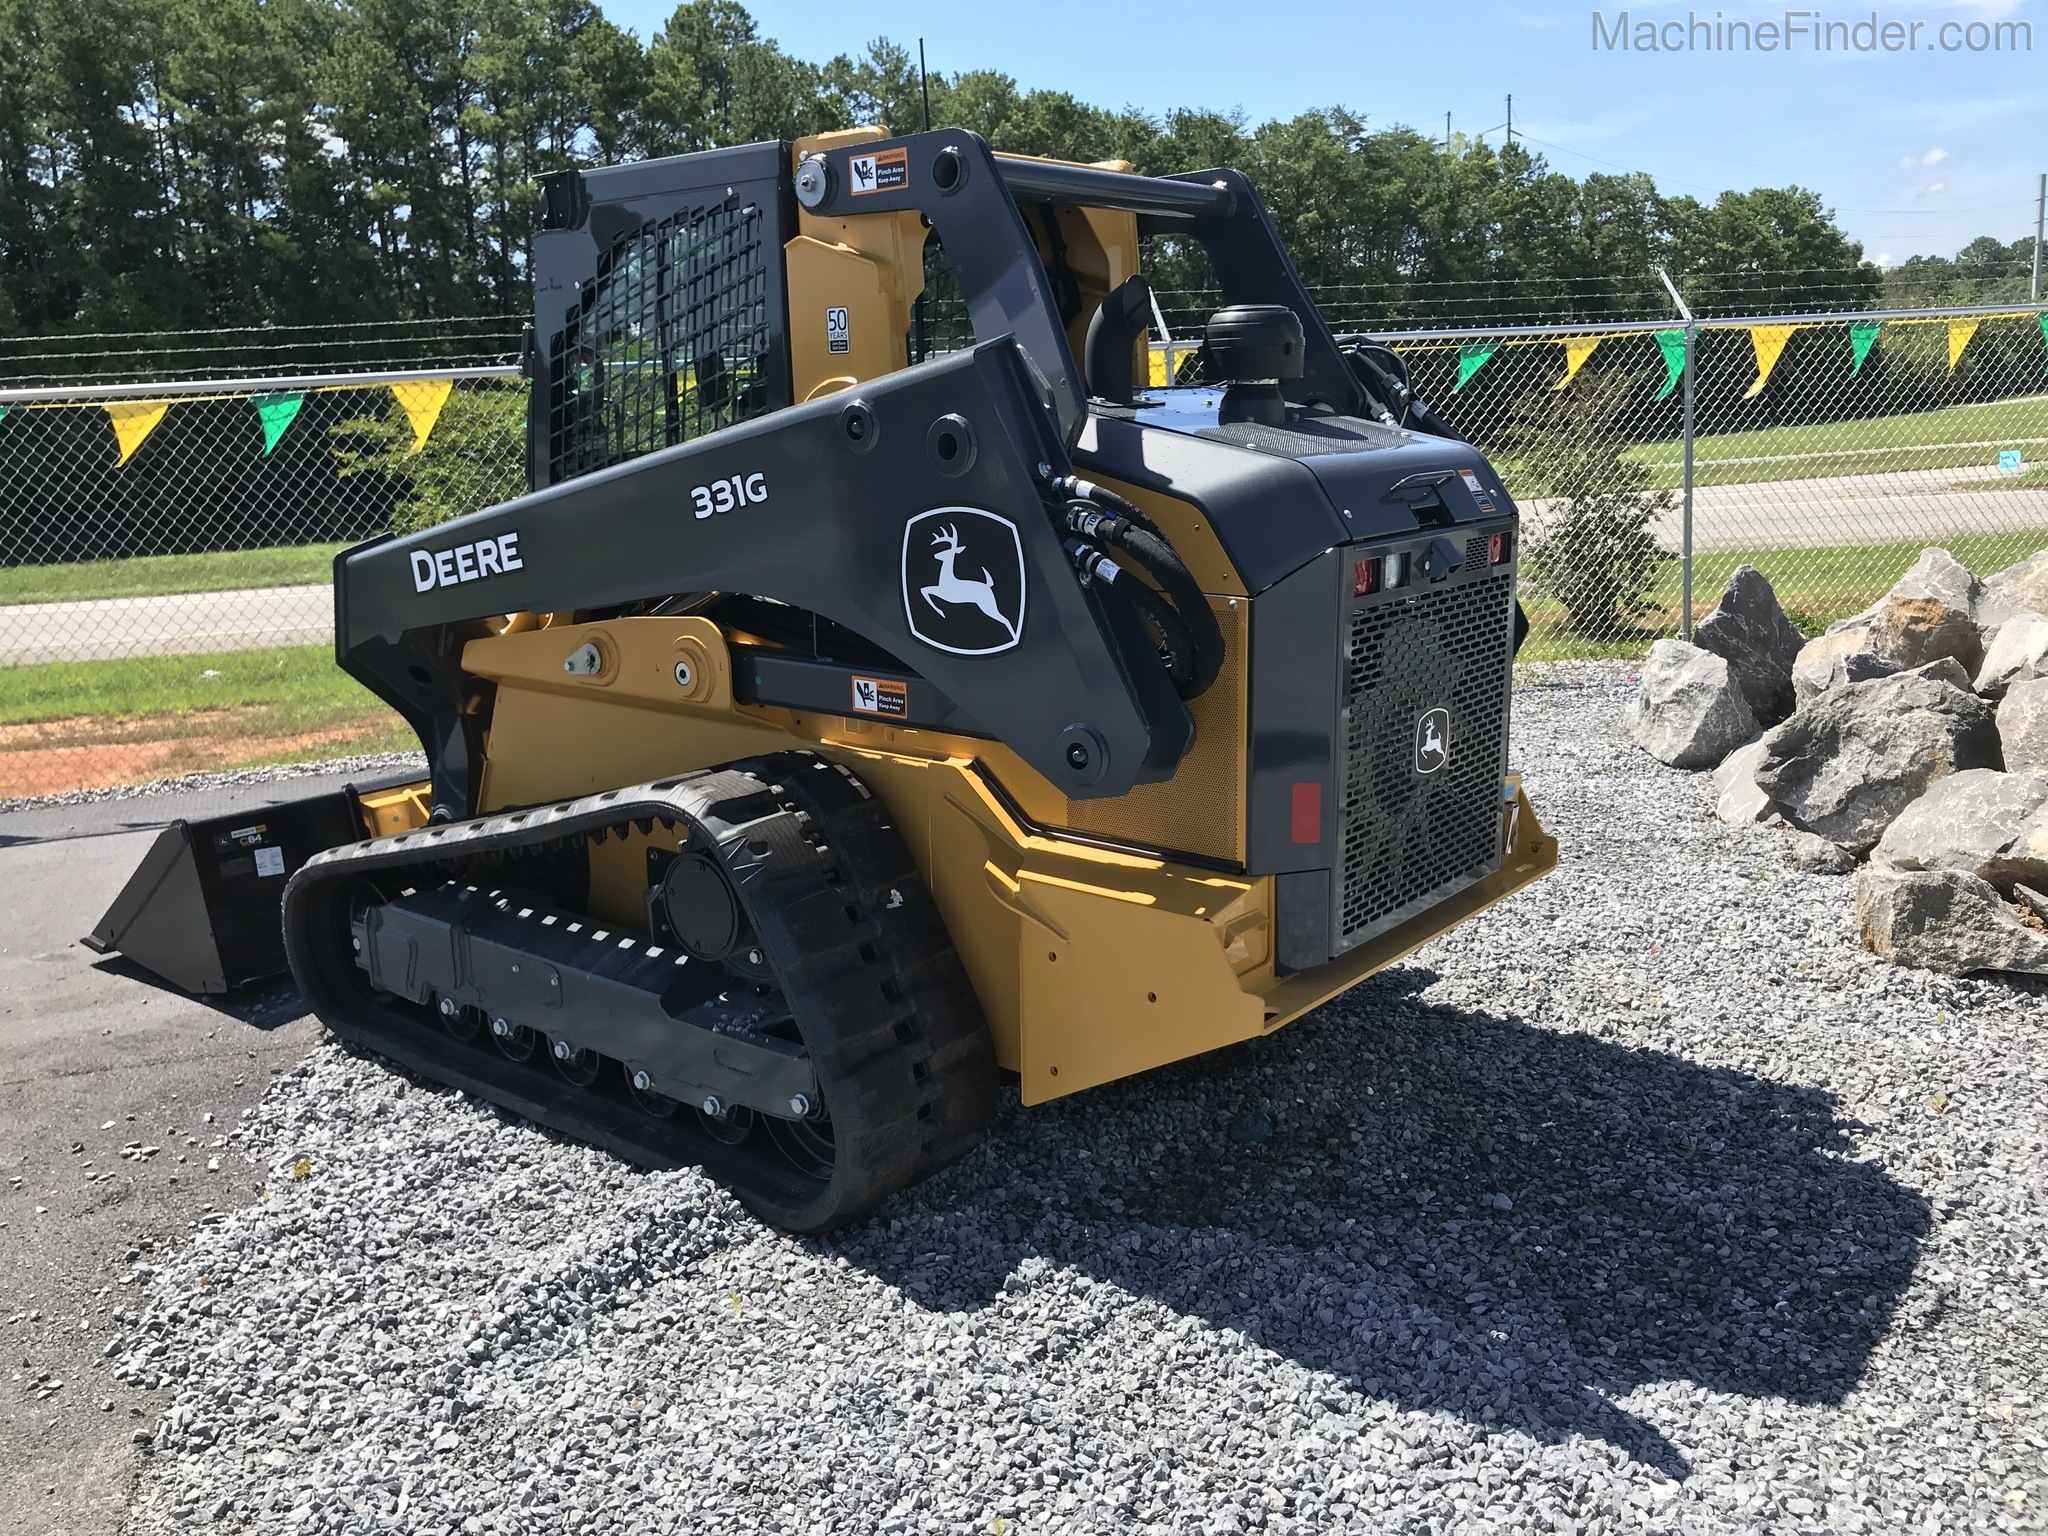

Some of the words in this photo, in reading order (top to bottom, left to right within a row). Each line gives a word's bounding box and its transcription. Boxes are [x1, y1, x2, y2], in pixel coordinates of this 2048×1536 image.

[878, 168, 892, 176] Pinch
[828, 309, 847, 331] 50
[829, 331, 847, 340] YEARS
[690, 472, 769, 520] 331G
[409, 531, 524, 594] DEERE
[878, 695, 892, 703] Pinch
[892, 697, 904, 705] Area
